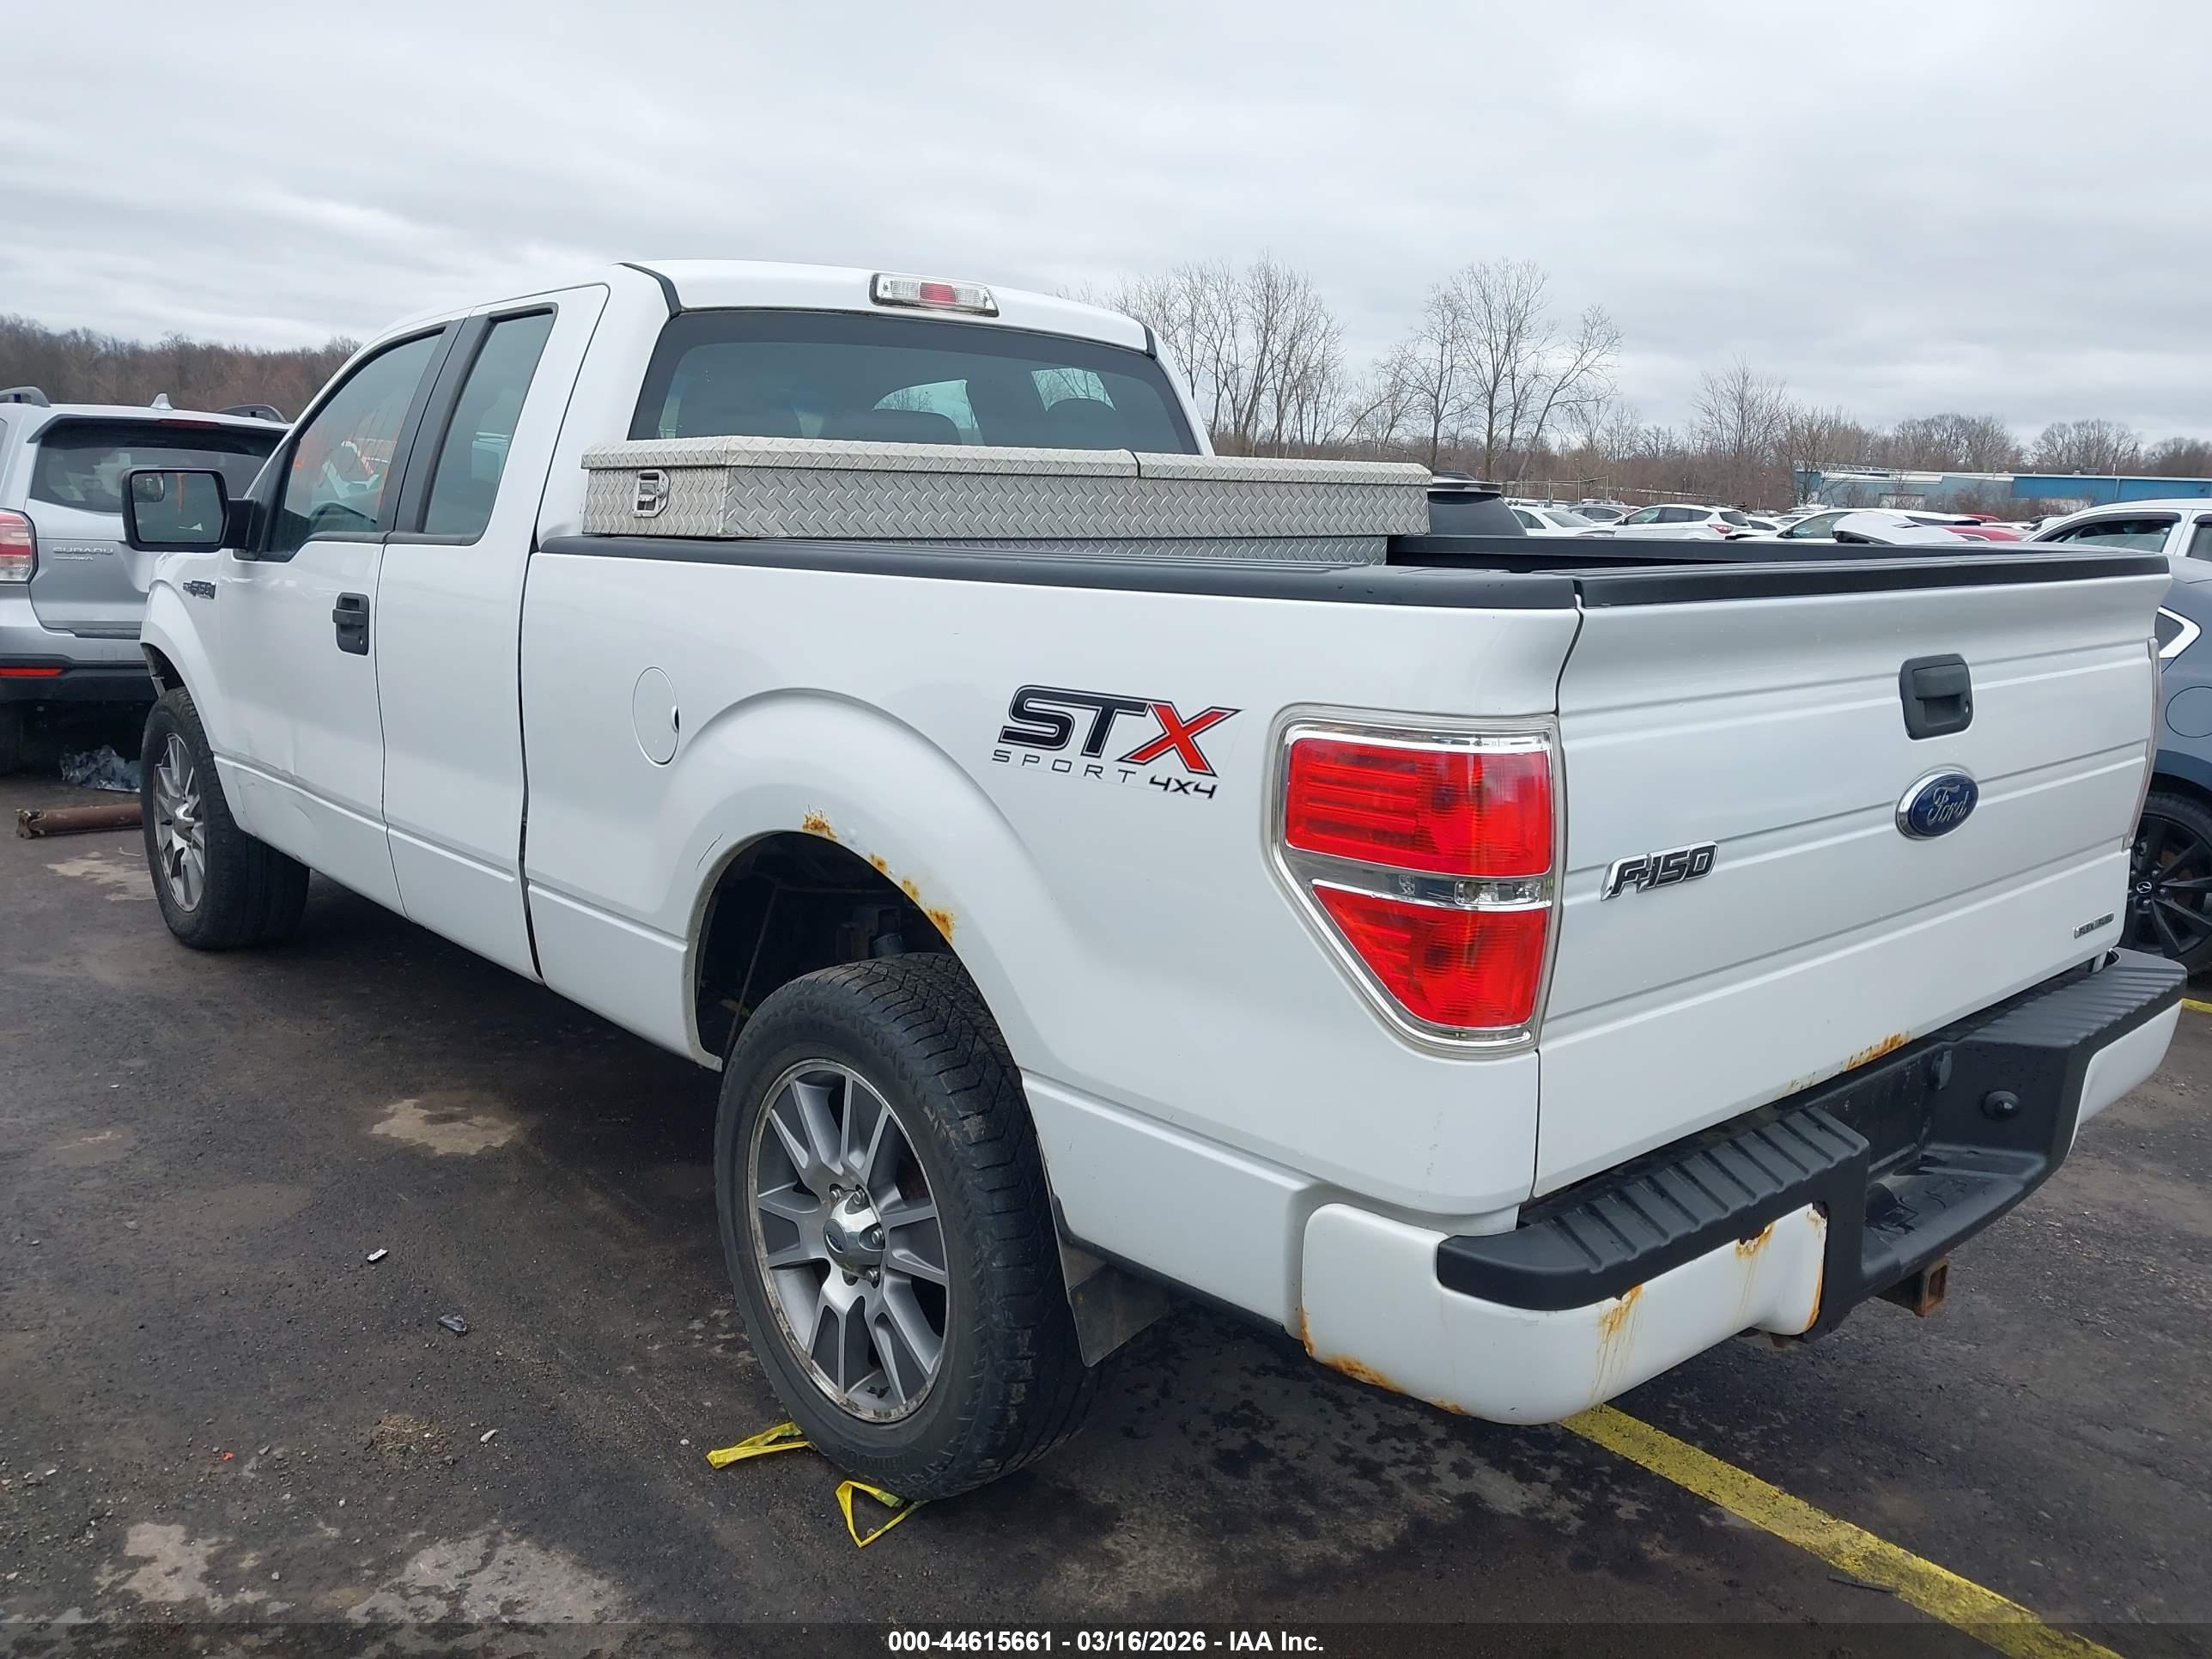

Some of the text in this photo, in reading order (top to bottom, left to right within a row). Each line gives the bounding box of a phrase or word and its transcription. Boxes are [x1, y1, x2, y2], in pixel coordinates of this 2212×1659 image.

[53, 547, 114, 556] SUBARU
[997, 684, 1244, 778] STX
[991, 749, 1137, 784] SPORT
[1926, 783, 1969, 827] Ford
